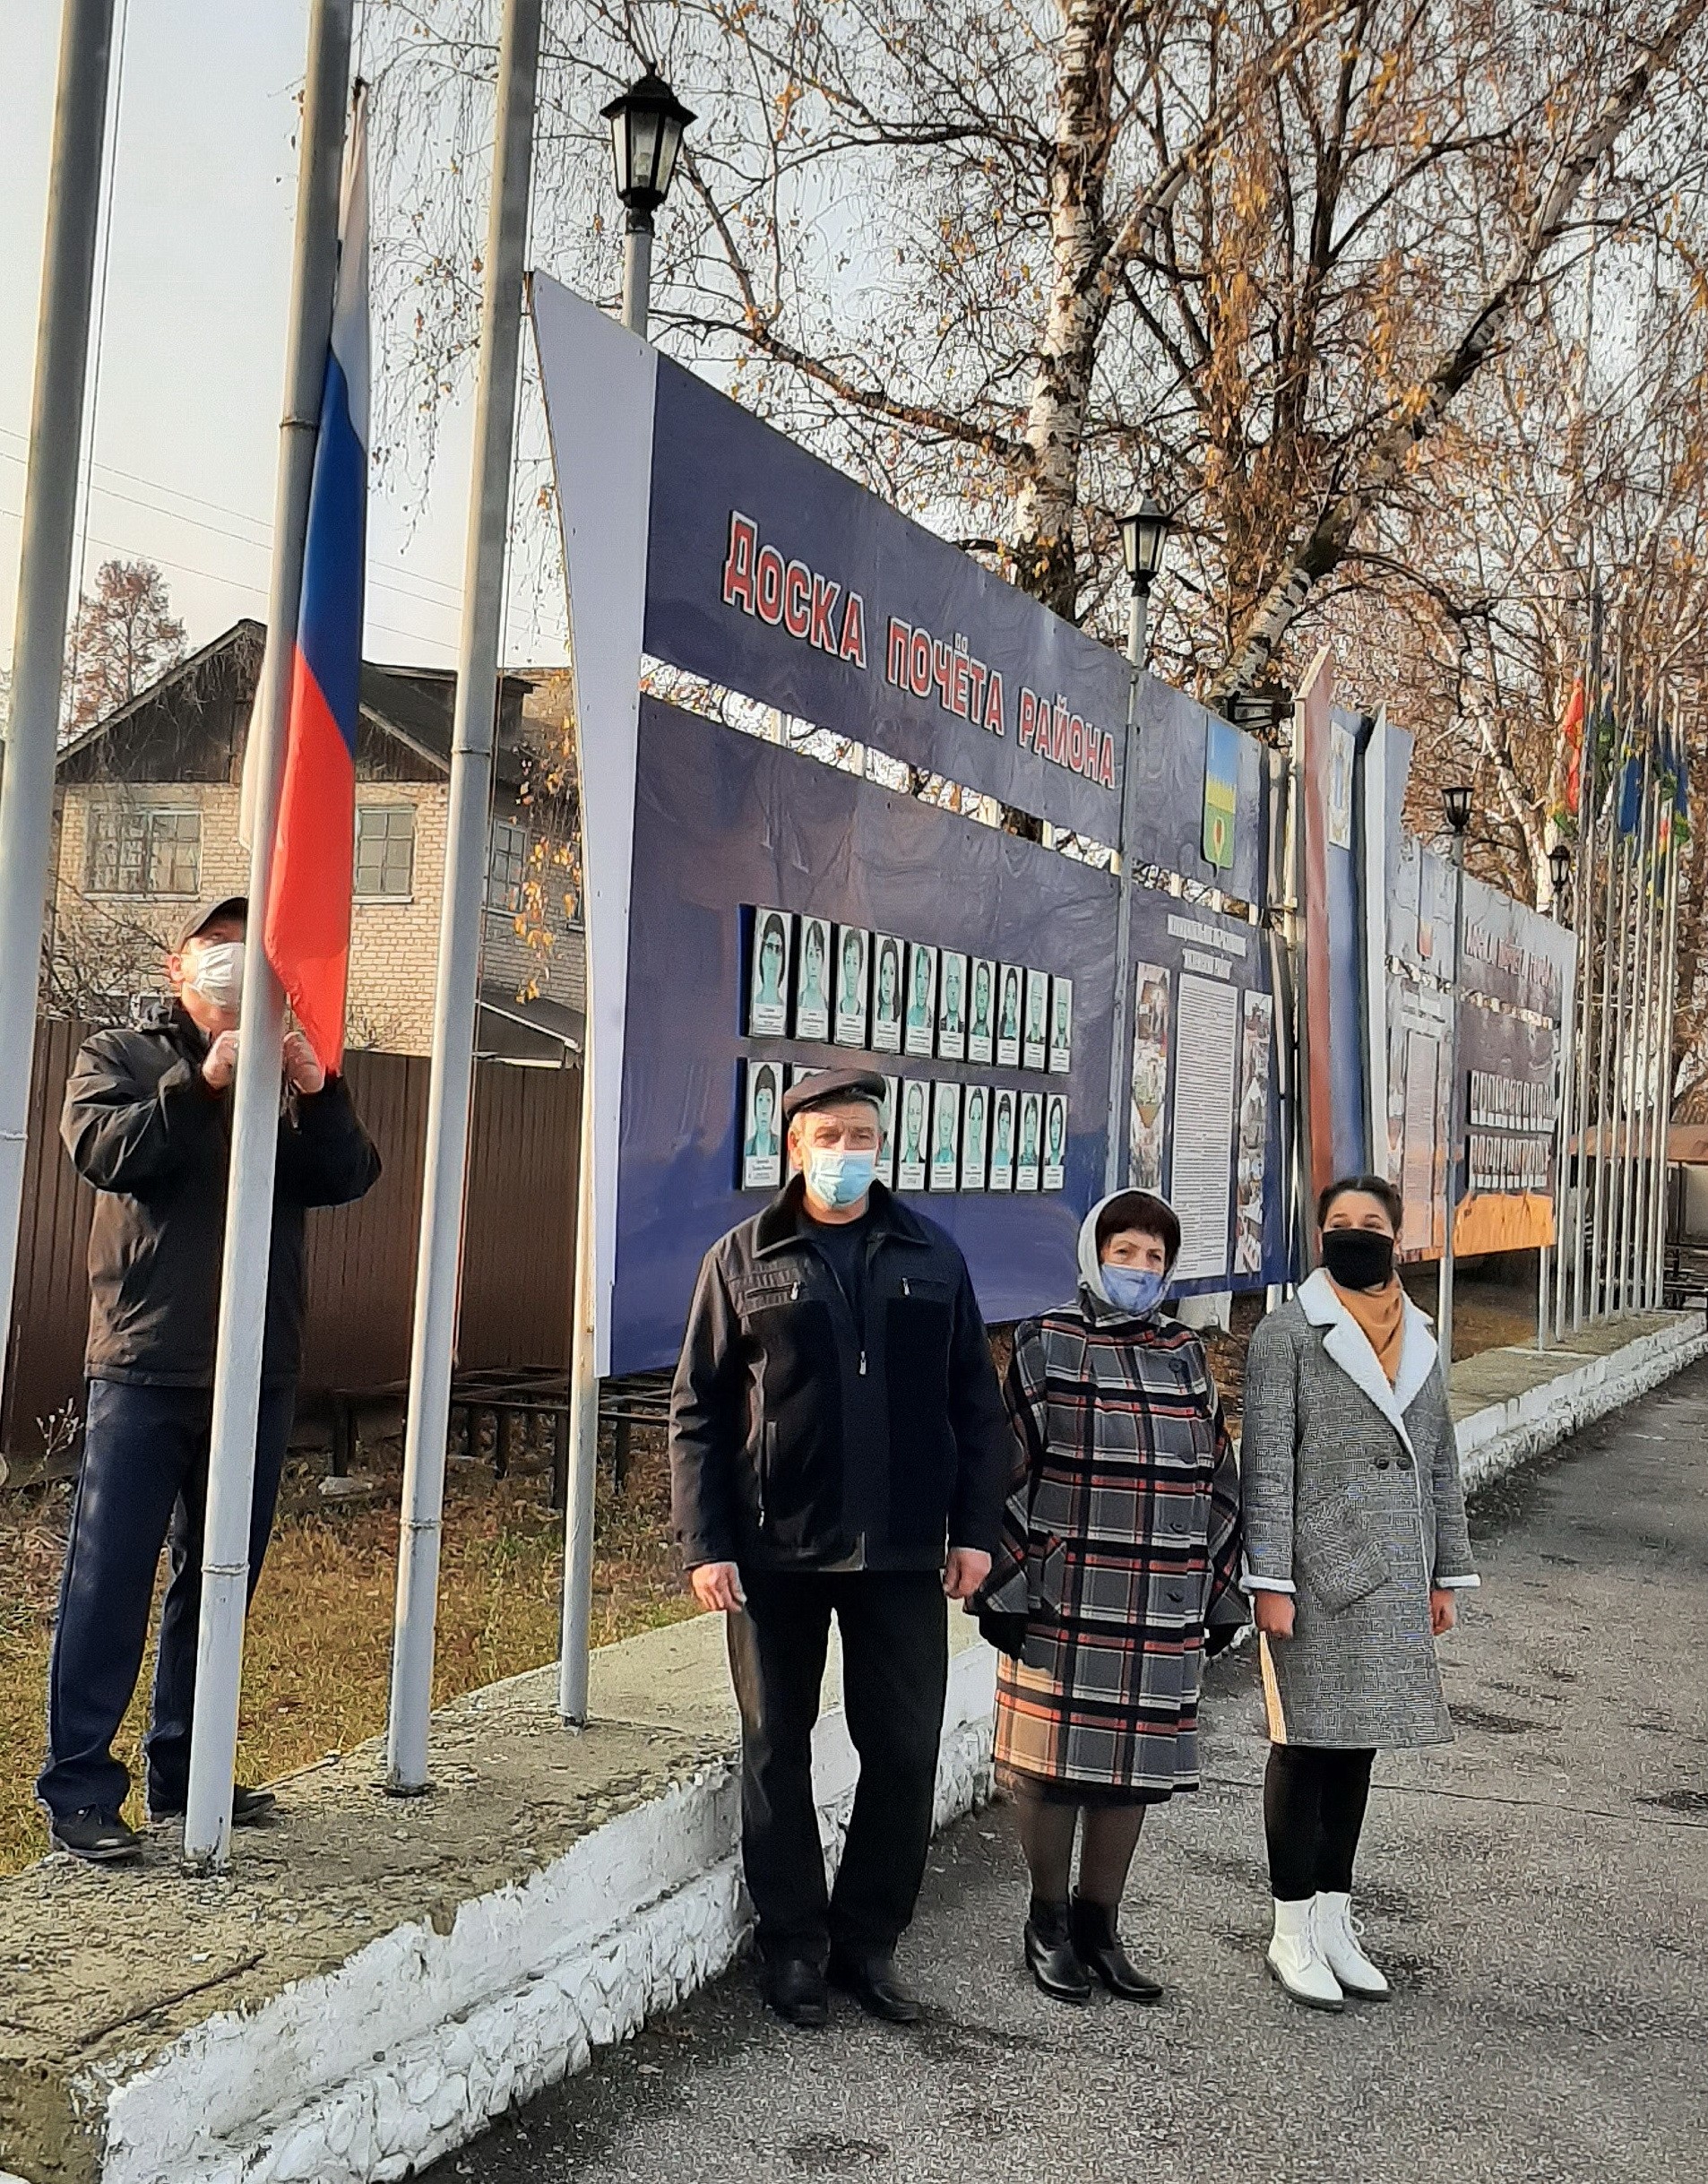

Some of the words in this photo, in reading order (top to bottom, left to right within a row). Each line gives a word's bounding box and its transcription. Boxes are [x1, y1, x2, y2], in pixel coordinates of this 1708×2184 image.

[723, 510, 867, 669] ДОСКА
[887, 617, 1005, 736] ПОЧЁТА
[1018, 686, 1115, 790] РАЙОНА
